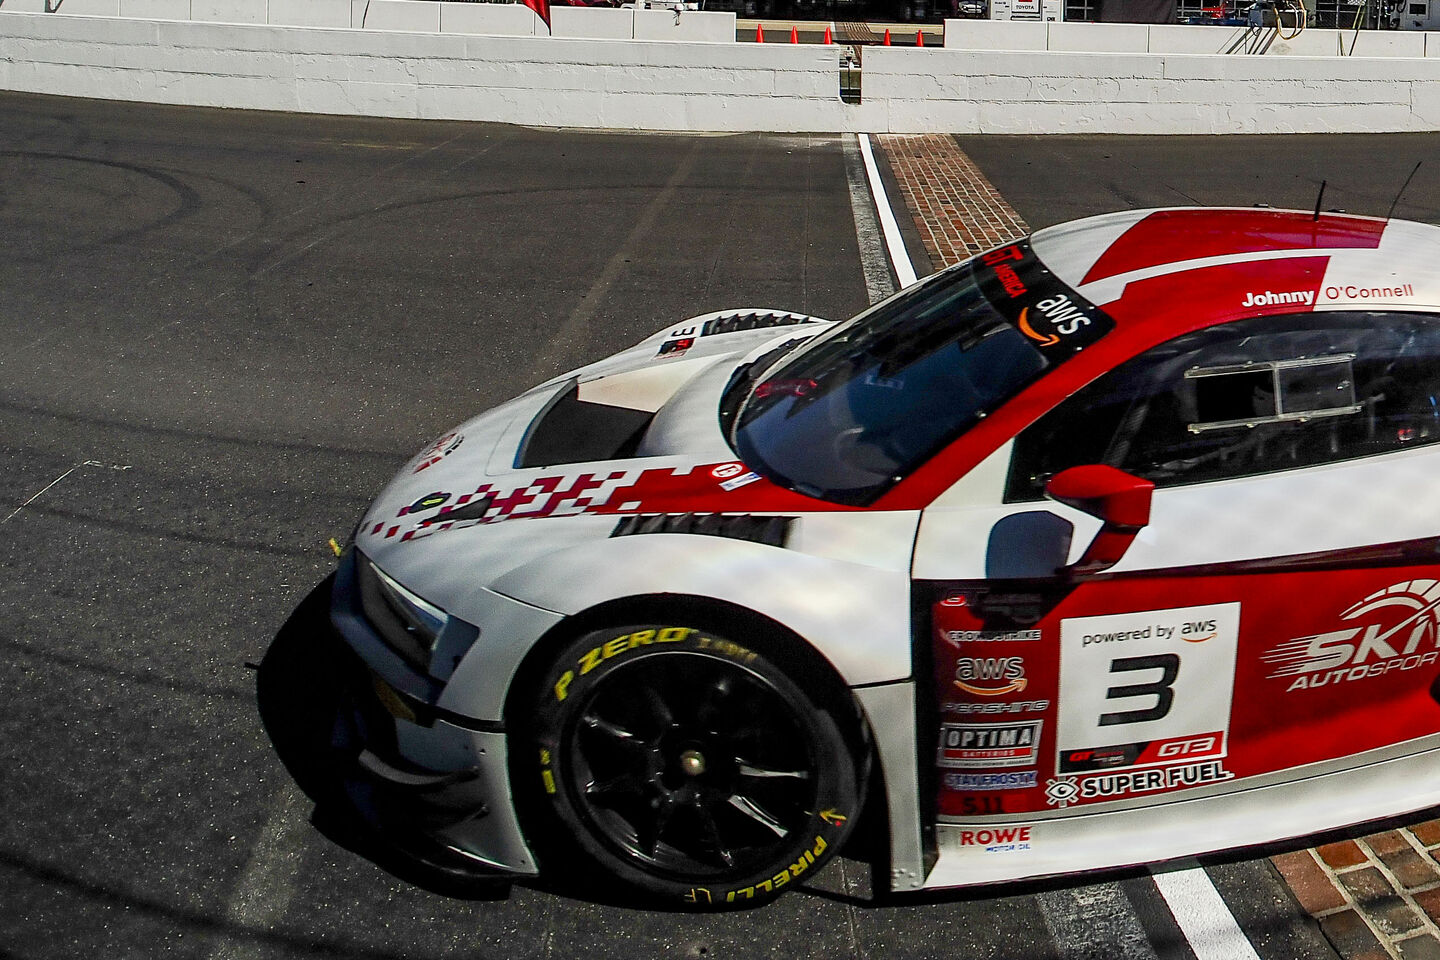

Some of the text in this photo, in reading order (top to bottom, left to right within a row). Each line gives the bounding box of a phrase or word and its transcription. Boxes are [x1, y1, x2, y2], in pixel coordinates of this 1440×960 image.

[982, 245, 1024, 266] GT
[1242, 284, 1414, 307] Johnny O'Connell
[1035, 294, 1091, 335] aws
[1082, 620, 1217, 648] powered by aws
[577, 626, 690, 676] ZERO
[956, 656, 1025, 680] aws
[1097, 653, 1181, 727] 3
[947, 728, 1033, 747] OPTIMA
[1157, 737, 1216, 758] GT3
[983, 772, 1035, 784] FROSTY
[1082, 762, 1229, 797] SUPER FUEL
[961, 826, 1032, 846] ROWE
[726, 835, 828, 903] PIRELLI
